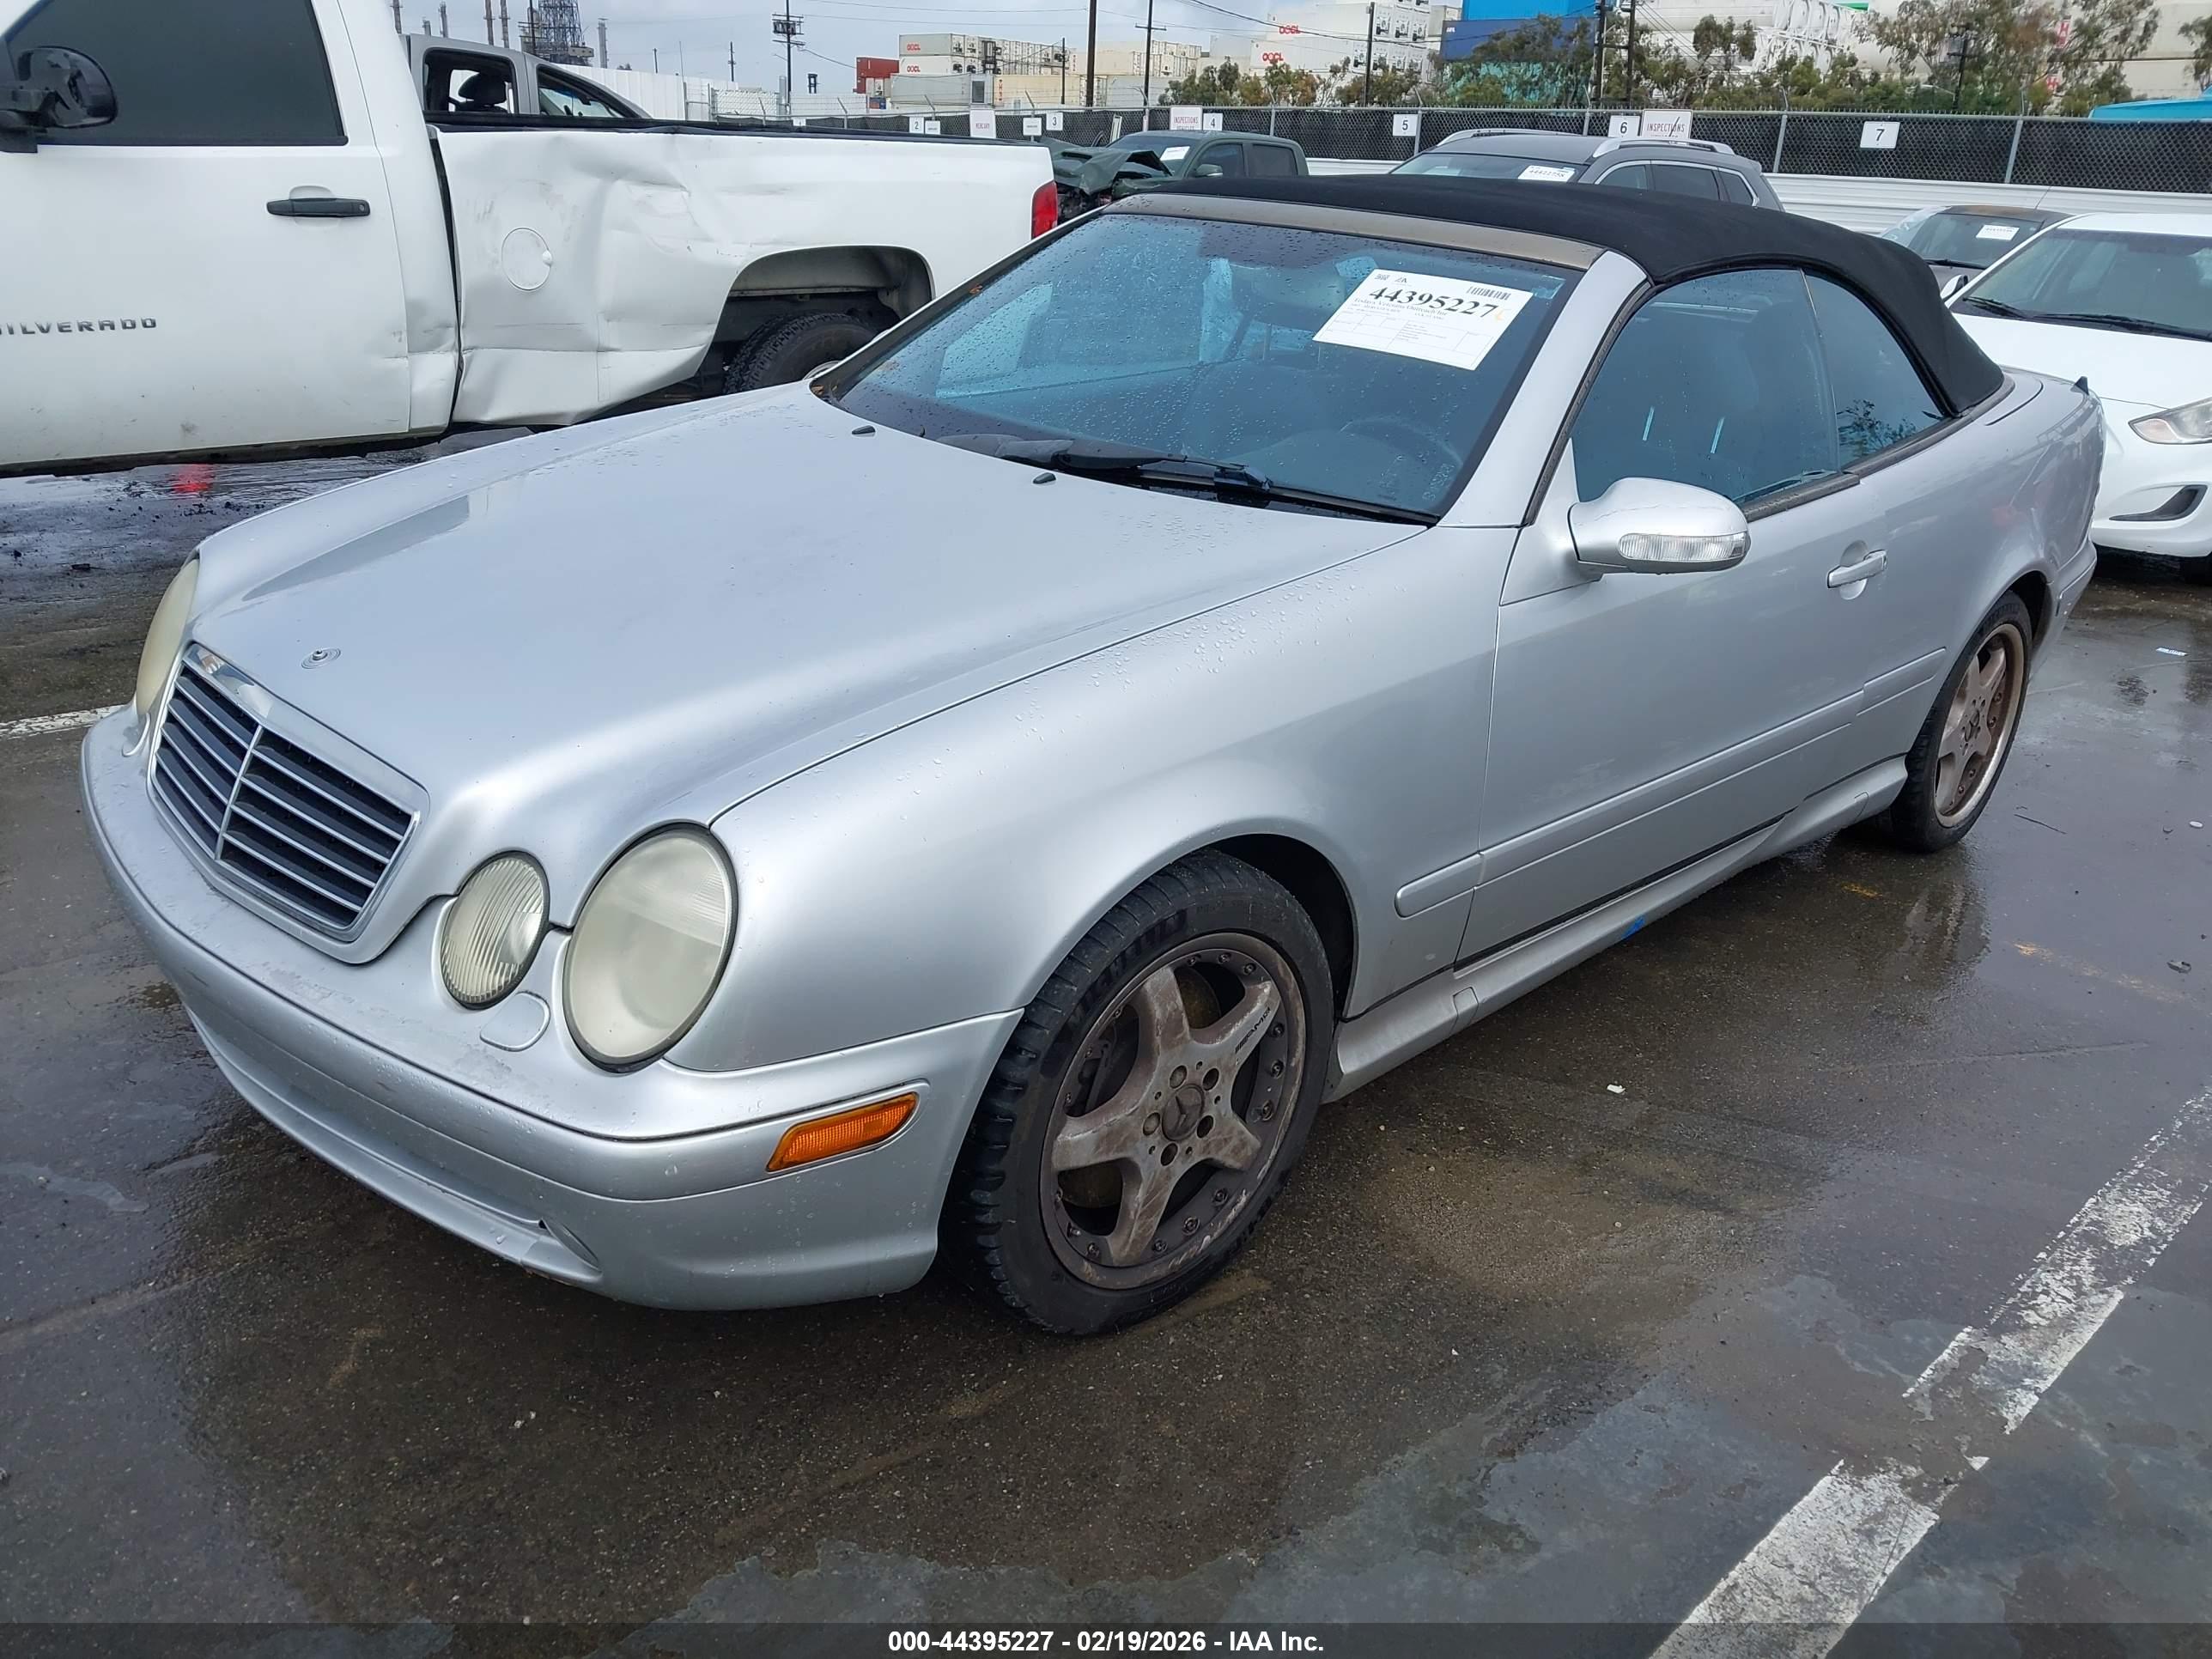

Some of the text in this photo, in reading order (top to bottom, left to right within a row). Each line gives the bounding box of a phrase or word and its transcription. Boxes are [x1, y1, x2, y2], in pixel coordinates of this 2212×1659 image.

[1052, 117, 1057, 126] 3
[1210, 118, 1216, 128] 4
[1402, 119, 1408, 131] 5
[1620, 121, 1628, 134] 6
[1647, 123, 1686, 132] INSPECTIONS
[1876, 128, 1886, 142] 7
[1369, 287, 1498, 318] 44395227
[0, 318, 157, 335] ILVERADO
